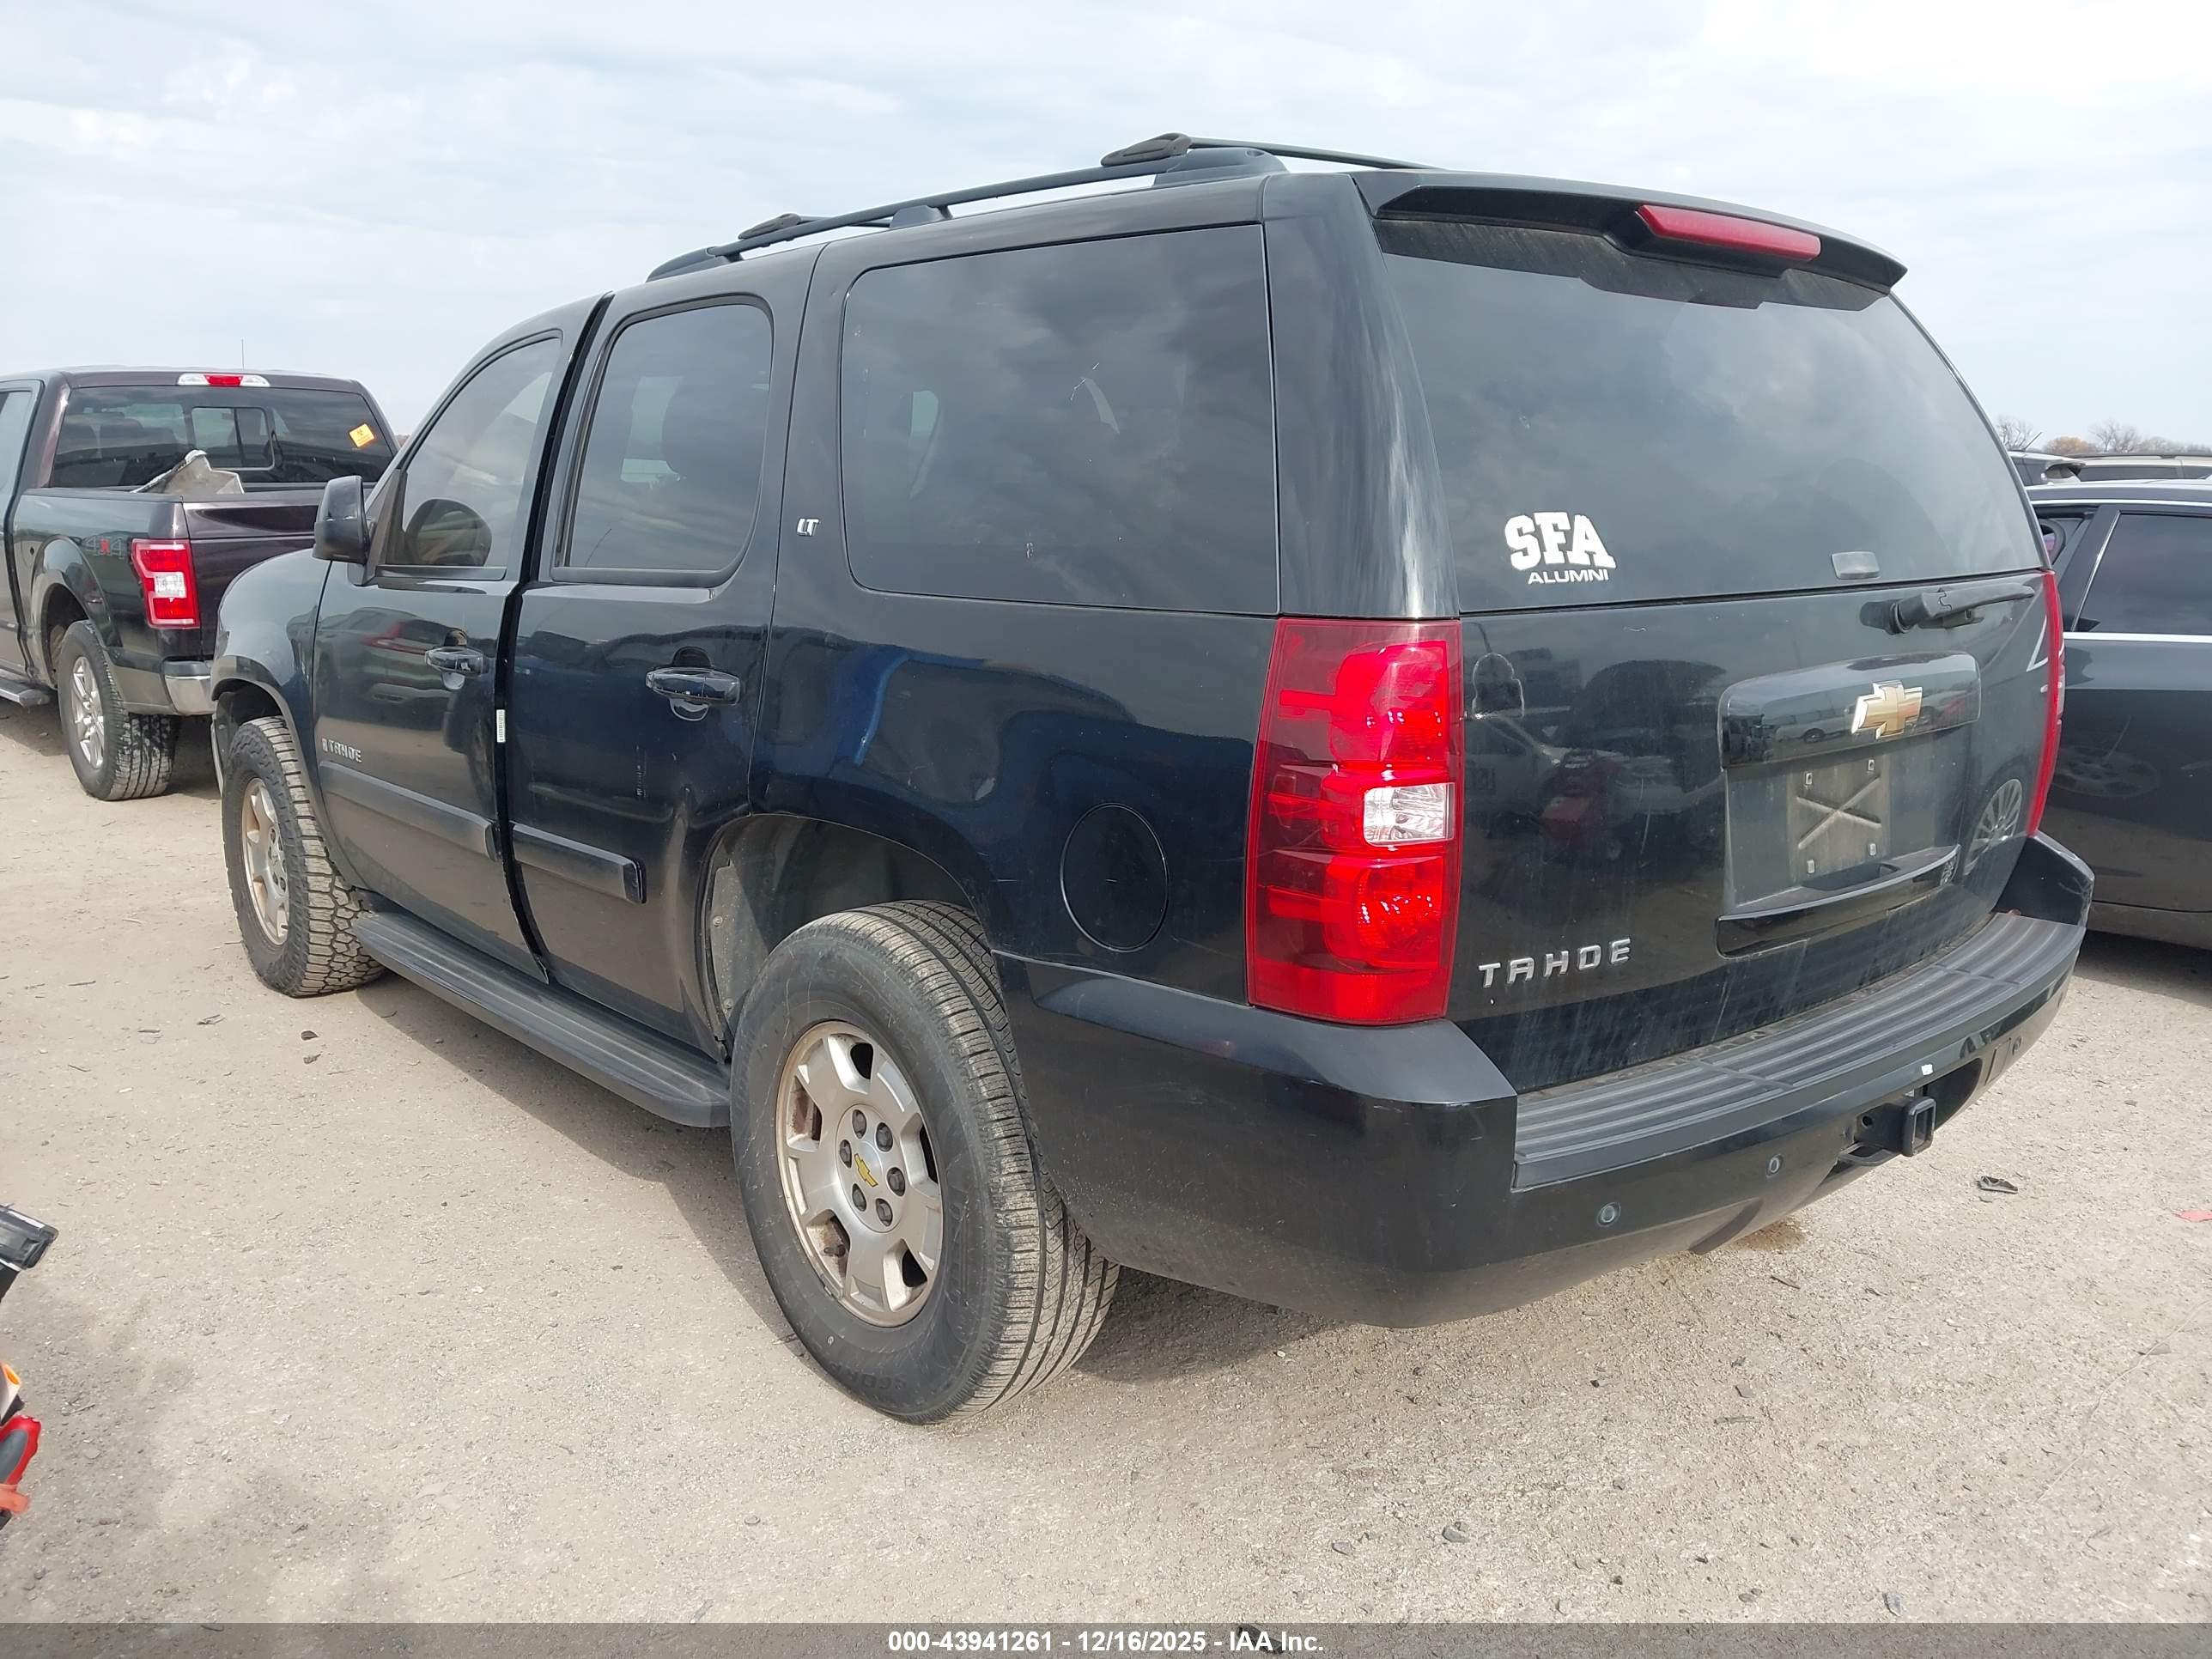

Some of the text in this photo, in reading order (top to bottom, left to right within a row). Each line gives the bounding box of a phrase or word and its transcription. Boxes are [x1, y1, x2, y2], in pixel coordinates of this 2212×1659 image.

[797, 518, 819, 536] LT
[1504, 512, 1616, 570] SFA
[1528, 568, 1608, 584] ALUMNI
[1479, 937, 1631, 988] TAHOE
